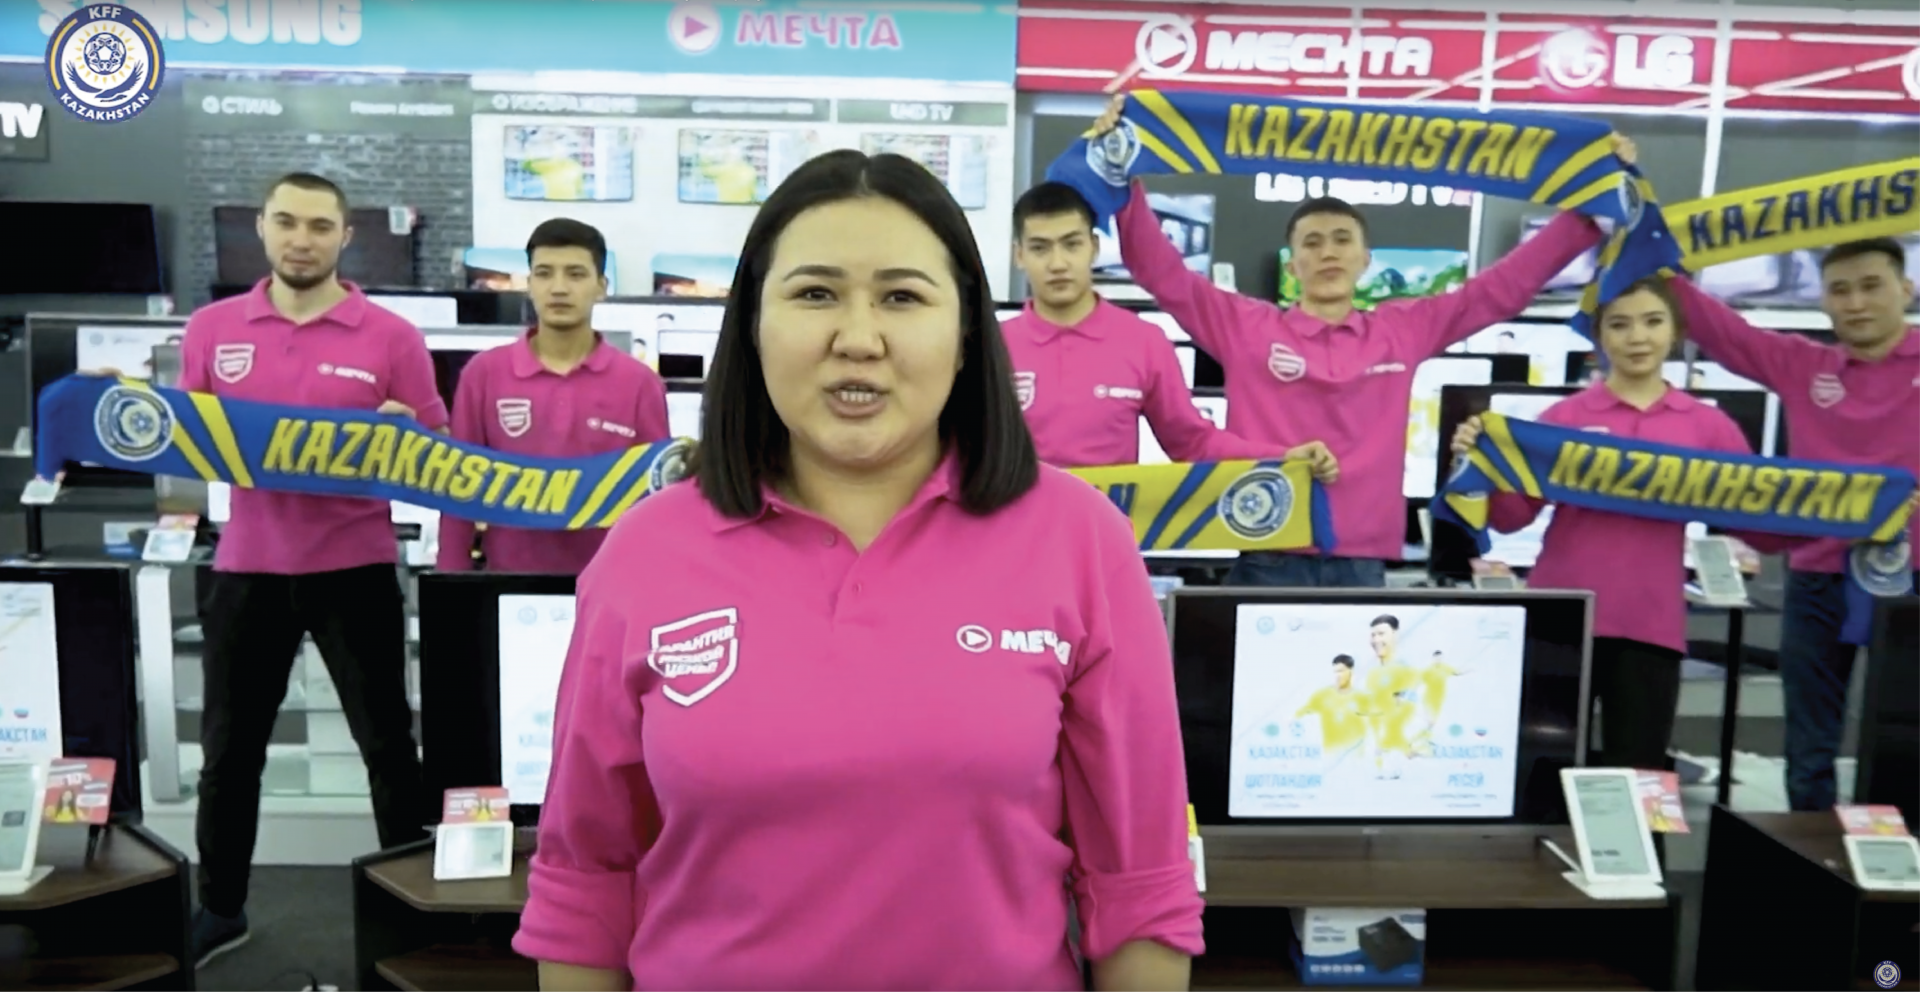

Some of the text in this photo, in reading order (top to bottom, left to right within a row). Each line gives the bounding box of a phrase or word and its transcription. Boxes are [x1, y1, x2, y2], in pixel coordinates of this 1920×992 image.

[38, 0, 362, 46] SMSUNG
[736, 12, 902, 49] МЕЧТА
[1205, 31, 1434, 76] MECHTA
[1613, 34, 1694, 87] LG
[1225, 103, 1556, 181] KAZAKHSTAN
[1688, 169, 1919, 254] KAZAKHS
[263, 418, 580, 514] KAZAKHSTAN
[1549, 440, 1886, 522] KAZAKHSTAN
[1000, 629, 1071, 665] МЕЧА
